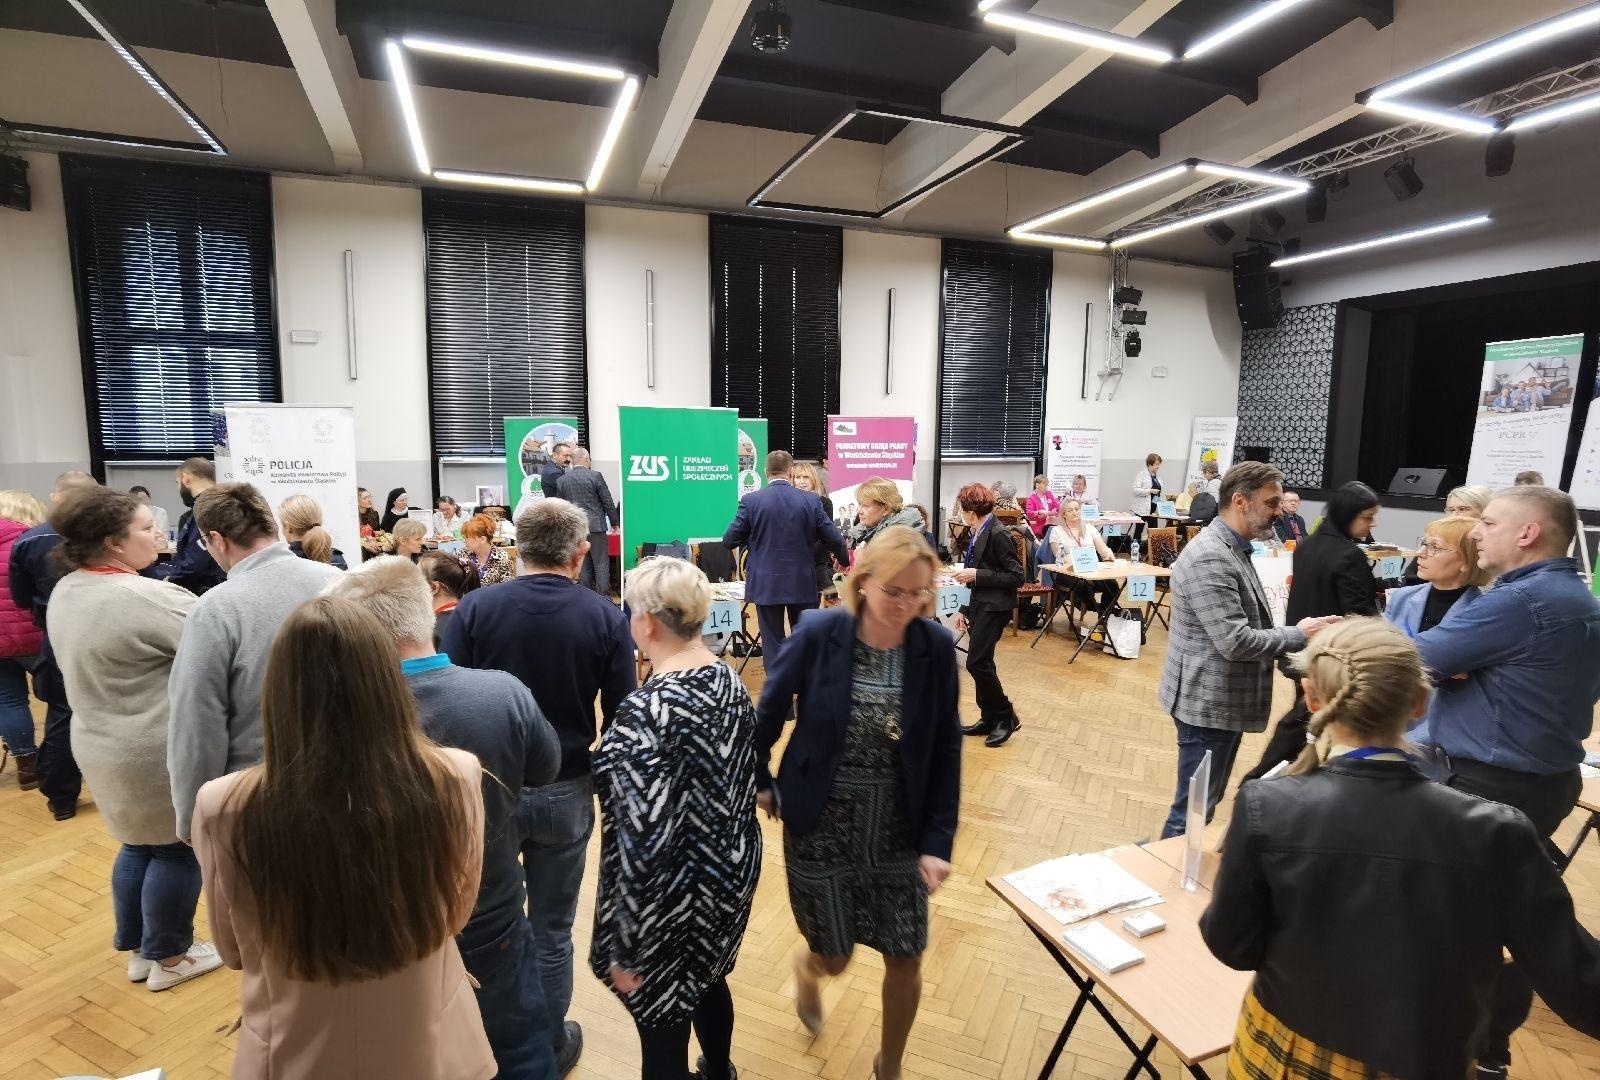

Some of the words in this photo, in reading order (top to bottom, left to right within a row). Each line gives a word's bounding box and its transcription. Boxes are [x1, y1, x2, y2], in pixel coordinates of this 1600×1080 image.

[269, 460, 312, 470] POLICJA
[627, 455, 669, 481] ZUS
[682, 464, 728, 472] UBEZPIECZEŃ
[682, 473, 733, 481] SPOŁECZNYCH
[1108, 524, 1114, 534] 8
[1132, 582, 1148, 597] 12
[940, 593, 960, 611] 13
[709, 609, 732, 629] 14
